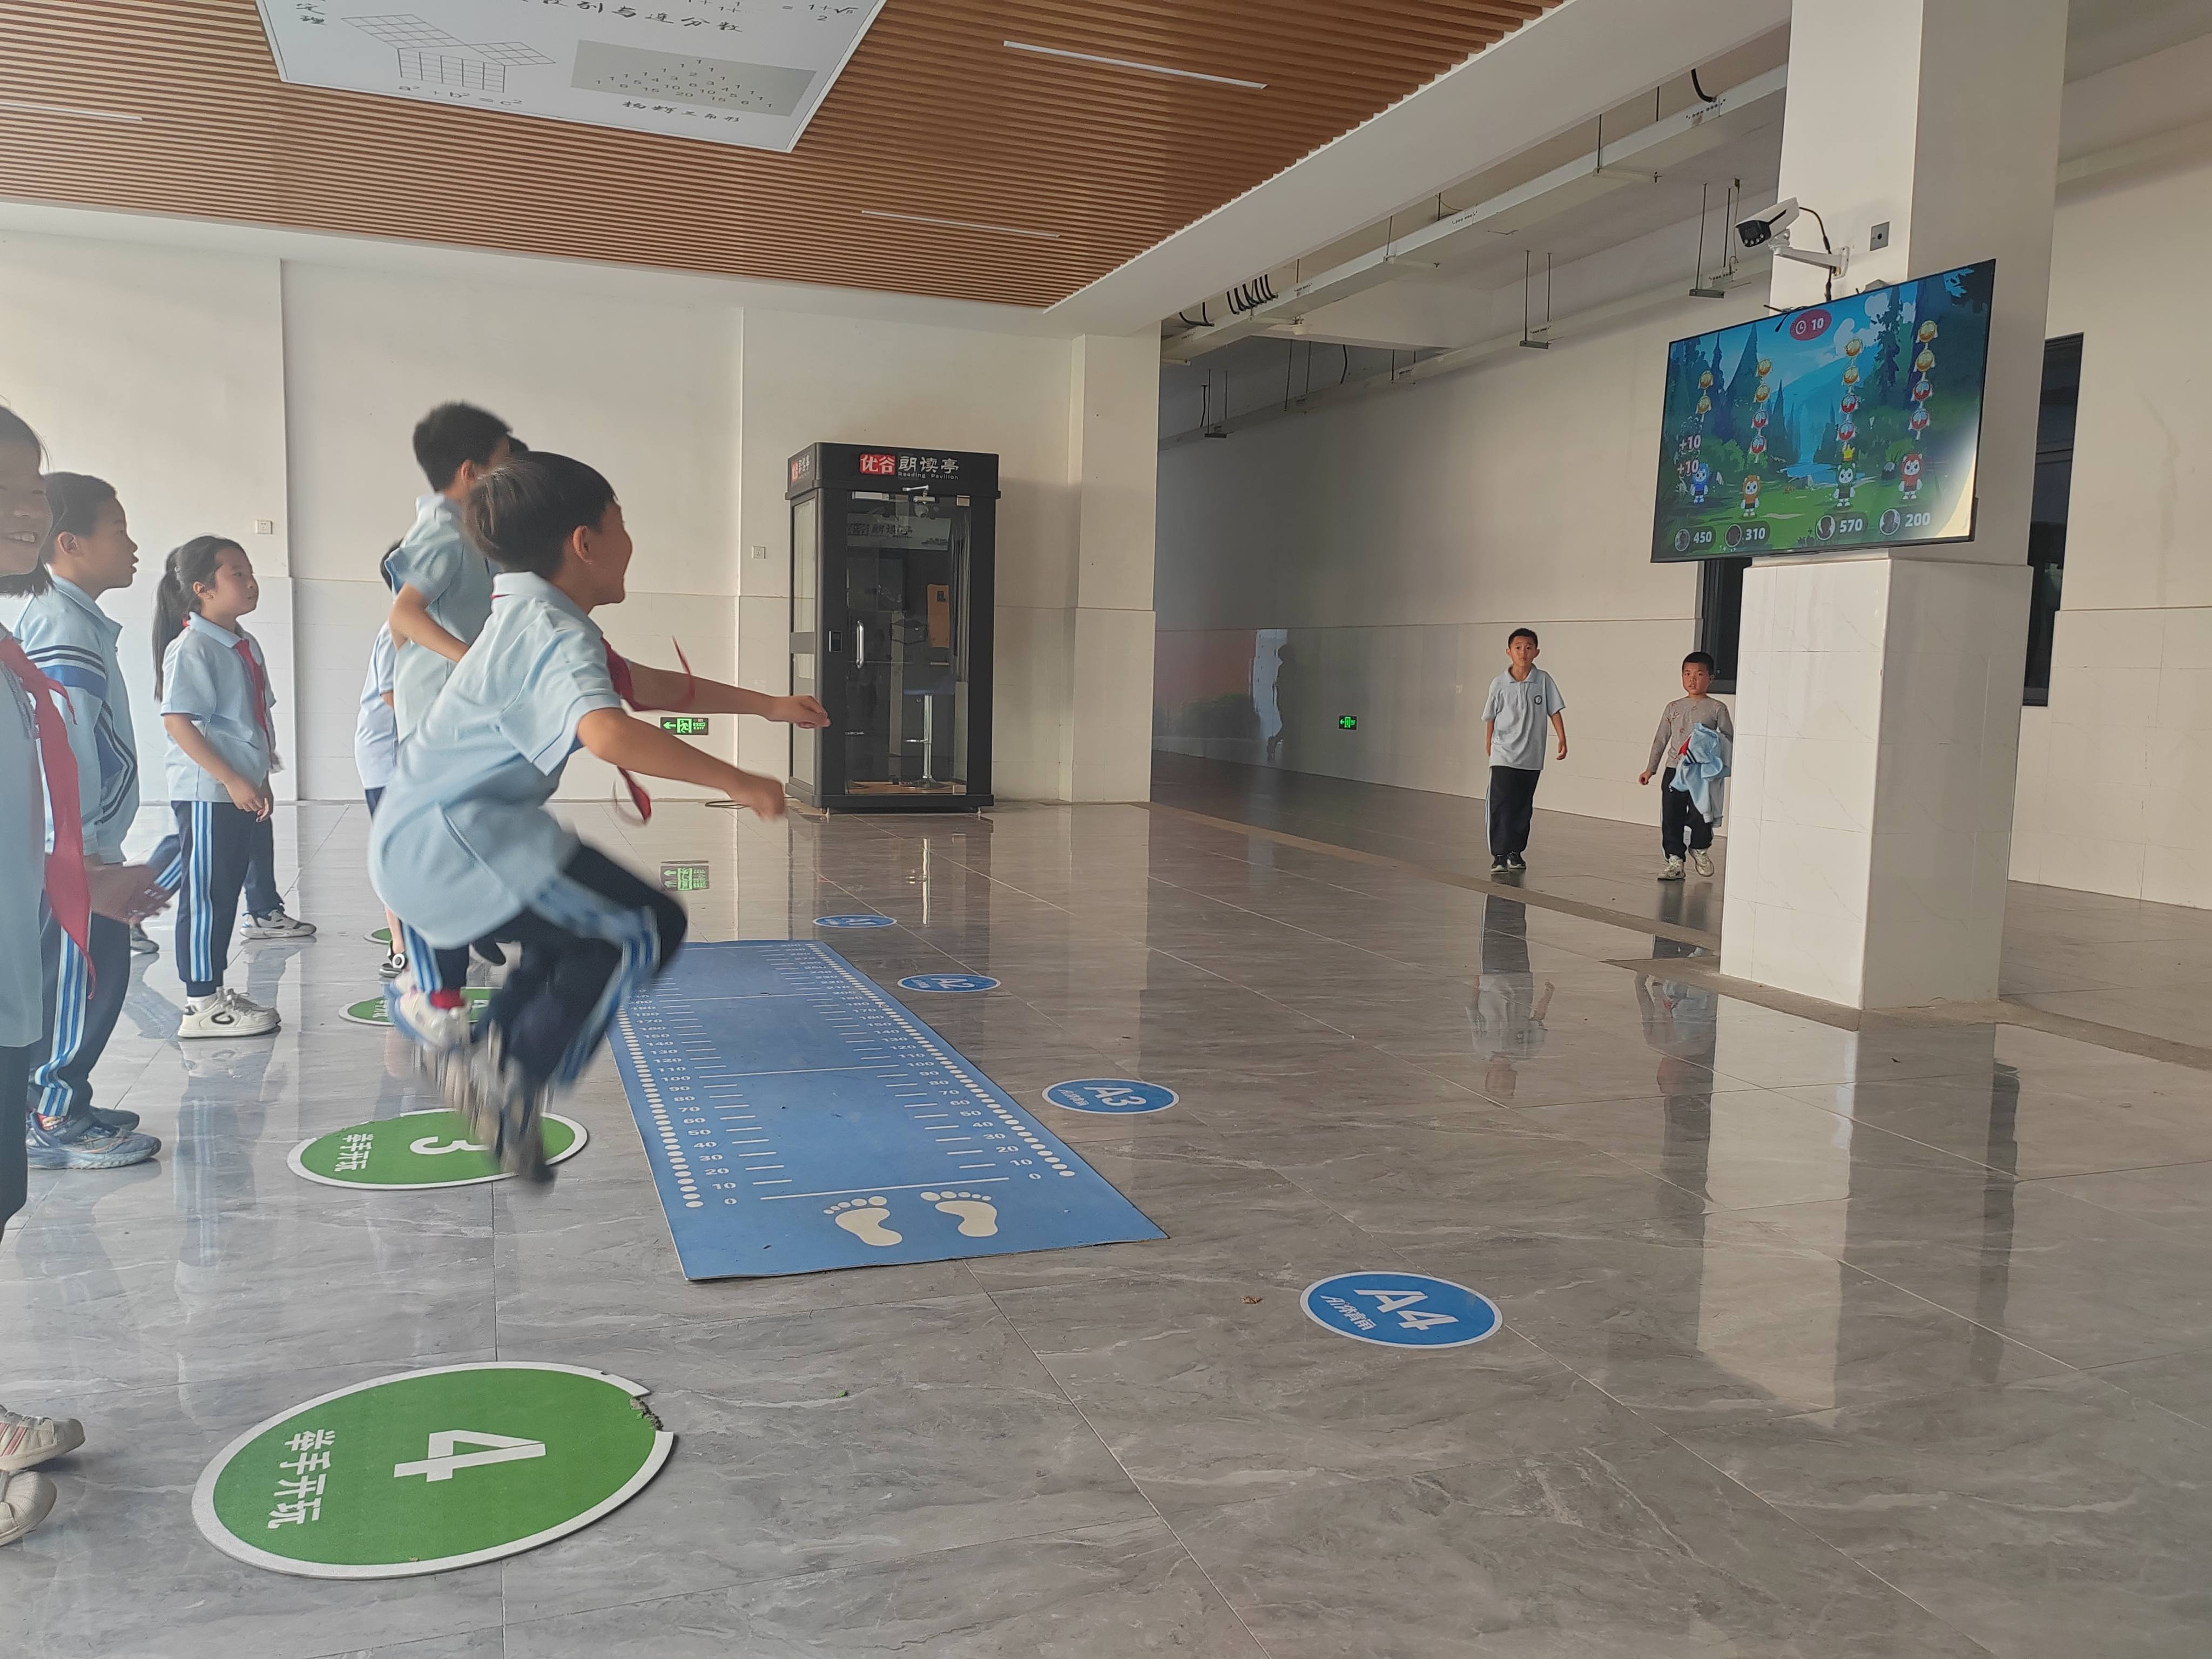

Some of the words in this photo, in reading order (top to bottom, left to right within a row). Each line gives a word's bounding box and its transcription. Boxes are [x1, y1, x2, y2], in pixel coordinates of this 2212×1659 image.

[1811, 317, 1824, 331] 10
[1679, 434, 1701, 449] +10
[860, 455, 895, 474] 优谷
[898, 456, 959, 474] 朗读亭
[1677, 460, 1700, 474] +10
[898, 471, 926, 479] Reading
[931, 471, 959, 480] Pavilion
[1839, 518, 1863, 534] 570
[1904, 512, 1931, 528] 200
[1693, 531, 1712, 544] 450
[1745, 527, 1766, 541] 310
[930, 978, 975, 989] A2
[1083, 1087, 1147, 1106] A3
[334, 1134, 374, 1172] 举手开玩
[1353, 1290, 1459, 1331] A4
[393, 1429, 546, 1482] 4
[267, 1428, 336, 1529] 举手开玩
